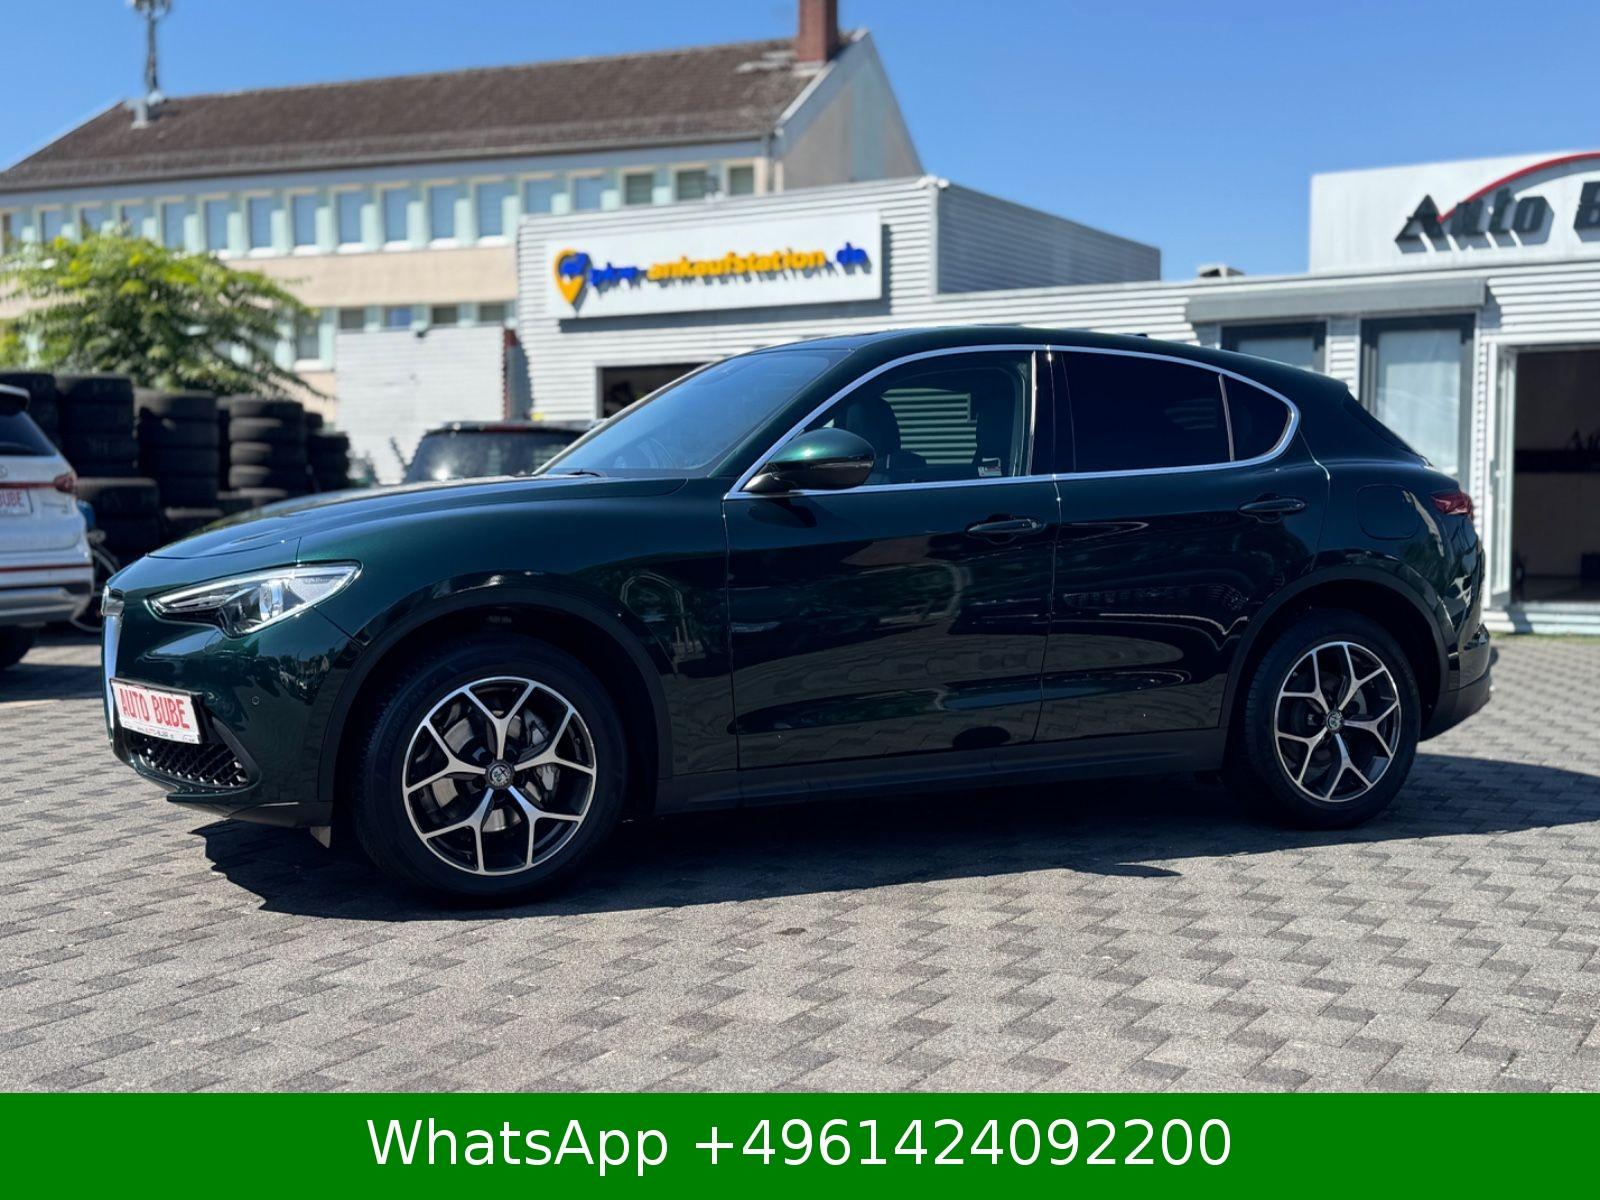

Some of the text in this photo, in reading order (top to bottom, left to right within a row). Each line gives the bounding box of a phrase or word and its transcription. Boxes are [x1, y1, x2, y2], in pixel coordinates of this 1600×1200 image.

[1395, 187, 1548, 241] Auto
[119, 688, 190, 729] AUTO BUBE
